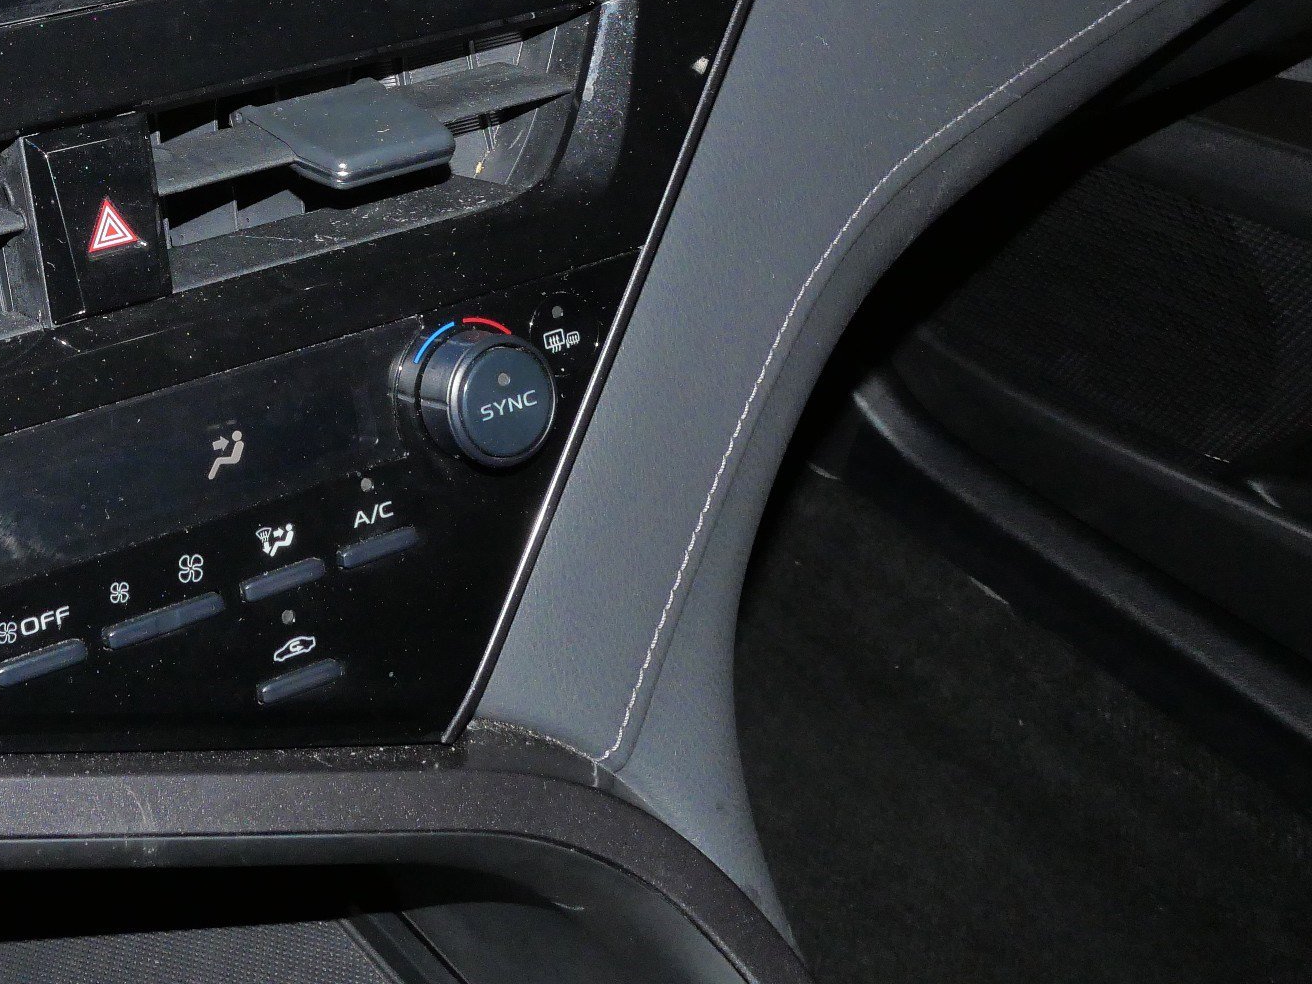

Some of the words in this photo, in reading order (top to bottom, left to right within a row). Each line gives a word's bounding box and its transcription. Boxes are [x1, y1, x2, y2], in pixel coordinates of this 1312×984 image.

[480, 389, 538, 422] SYNC
[353, 500, 394, 529] A/C
[20, 605, 71, 637] OFF
